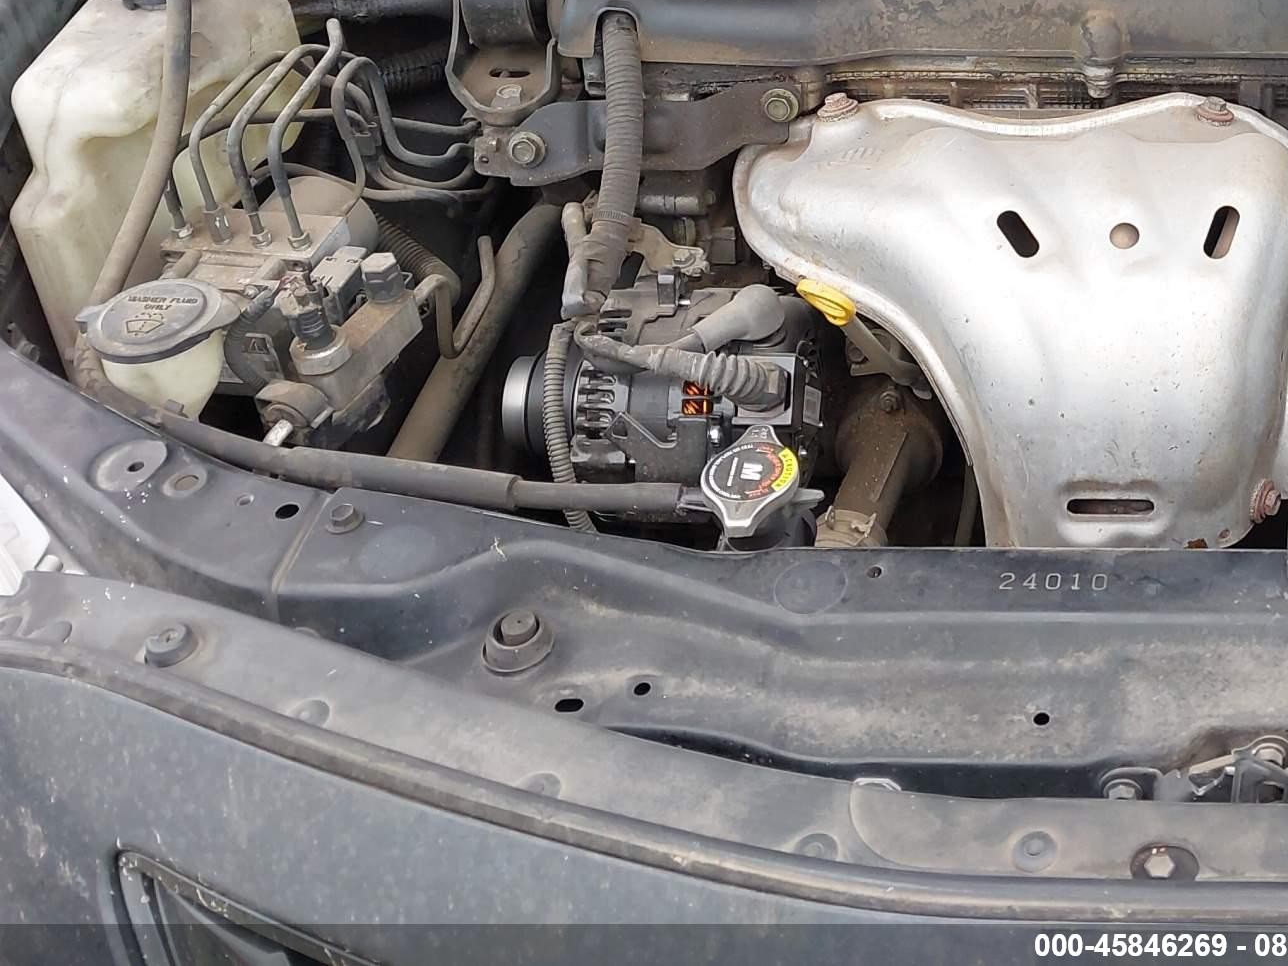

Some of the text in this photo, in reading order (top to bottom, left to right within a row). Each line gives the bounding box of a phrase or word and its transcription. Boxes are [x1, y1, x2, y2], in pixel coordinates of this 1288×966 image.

[128, 295, 198, 305] WASHER FLUID
[740, 462, 763, 481] M
[998, 572, 1109, 592] 24010
